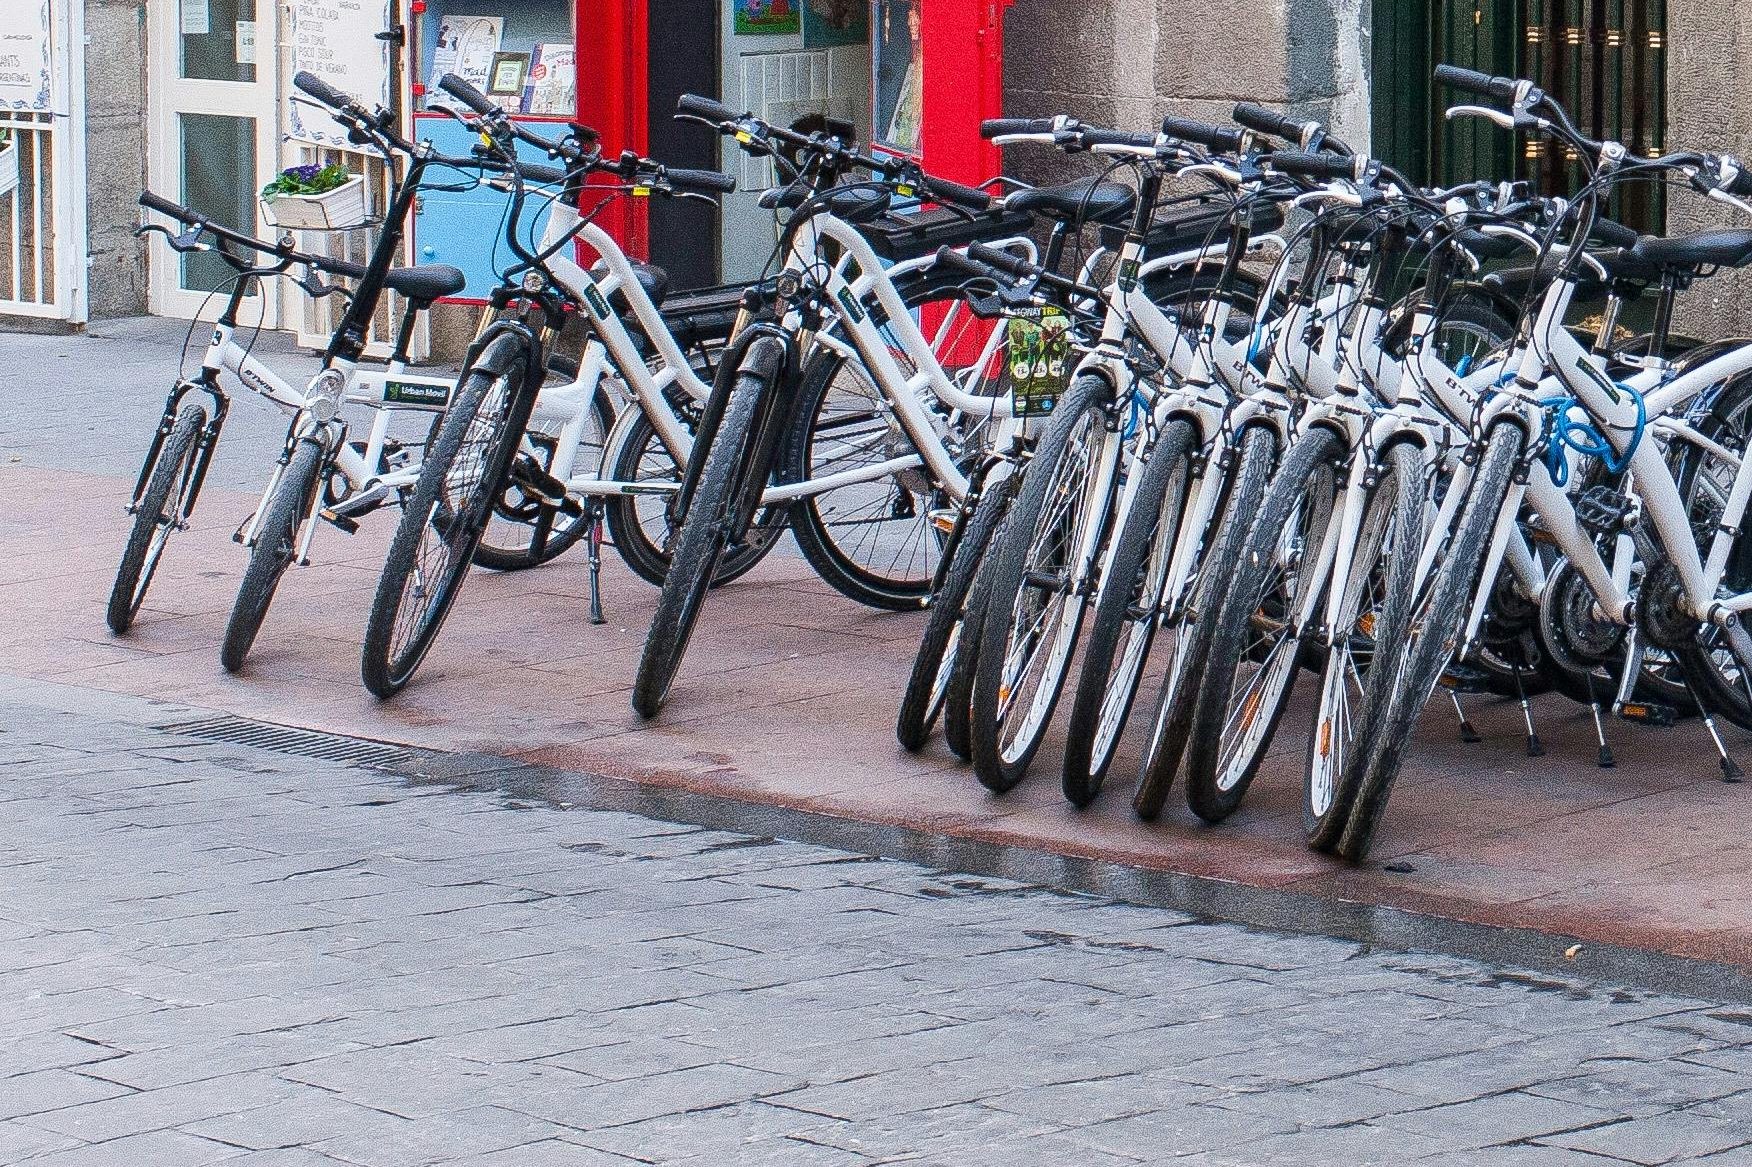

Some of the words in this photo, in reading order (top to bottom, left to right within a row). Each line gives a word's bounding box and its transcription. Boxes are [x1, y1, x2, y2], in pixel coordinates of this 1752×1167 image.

[244, 369, 276, 393] BTWIN
[1232, 360, 1264, 388] BTW
[402, 386, 424, 396] Urban
[1445, 377, 1476, 403] BTW
